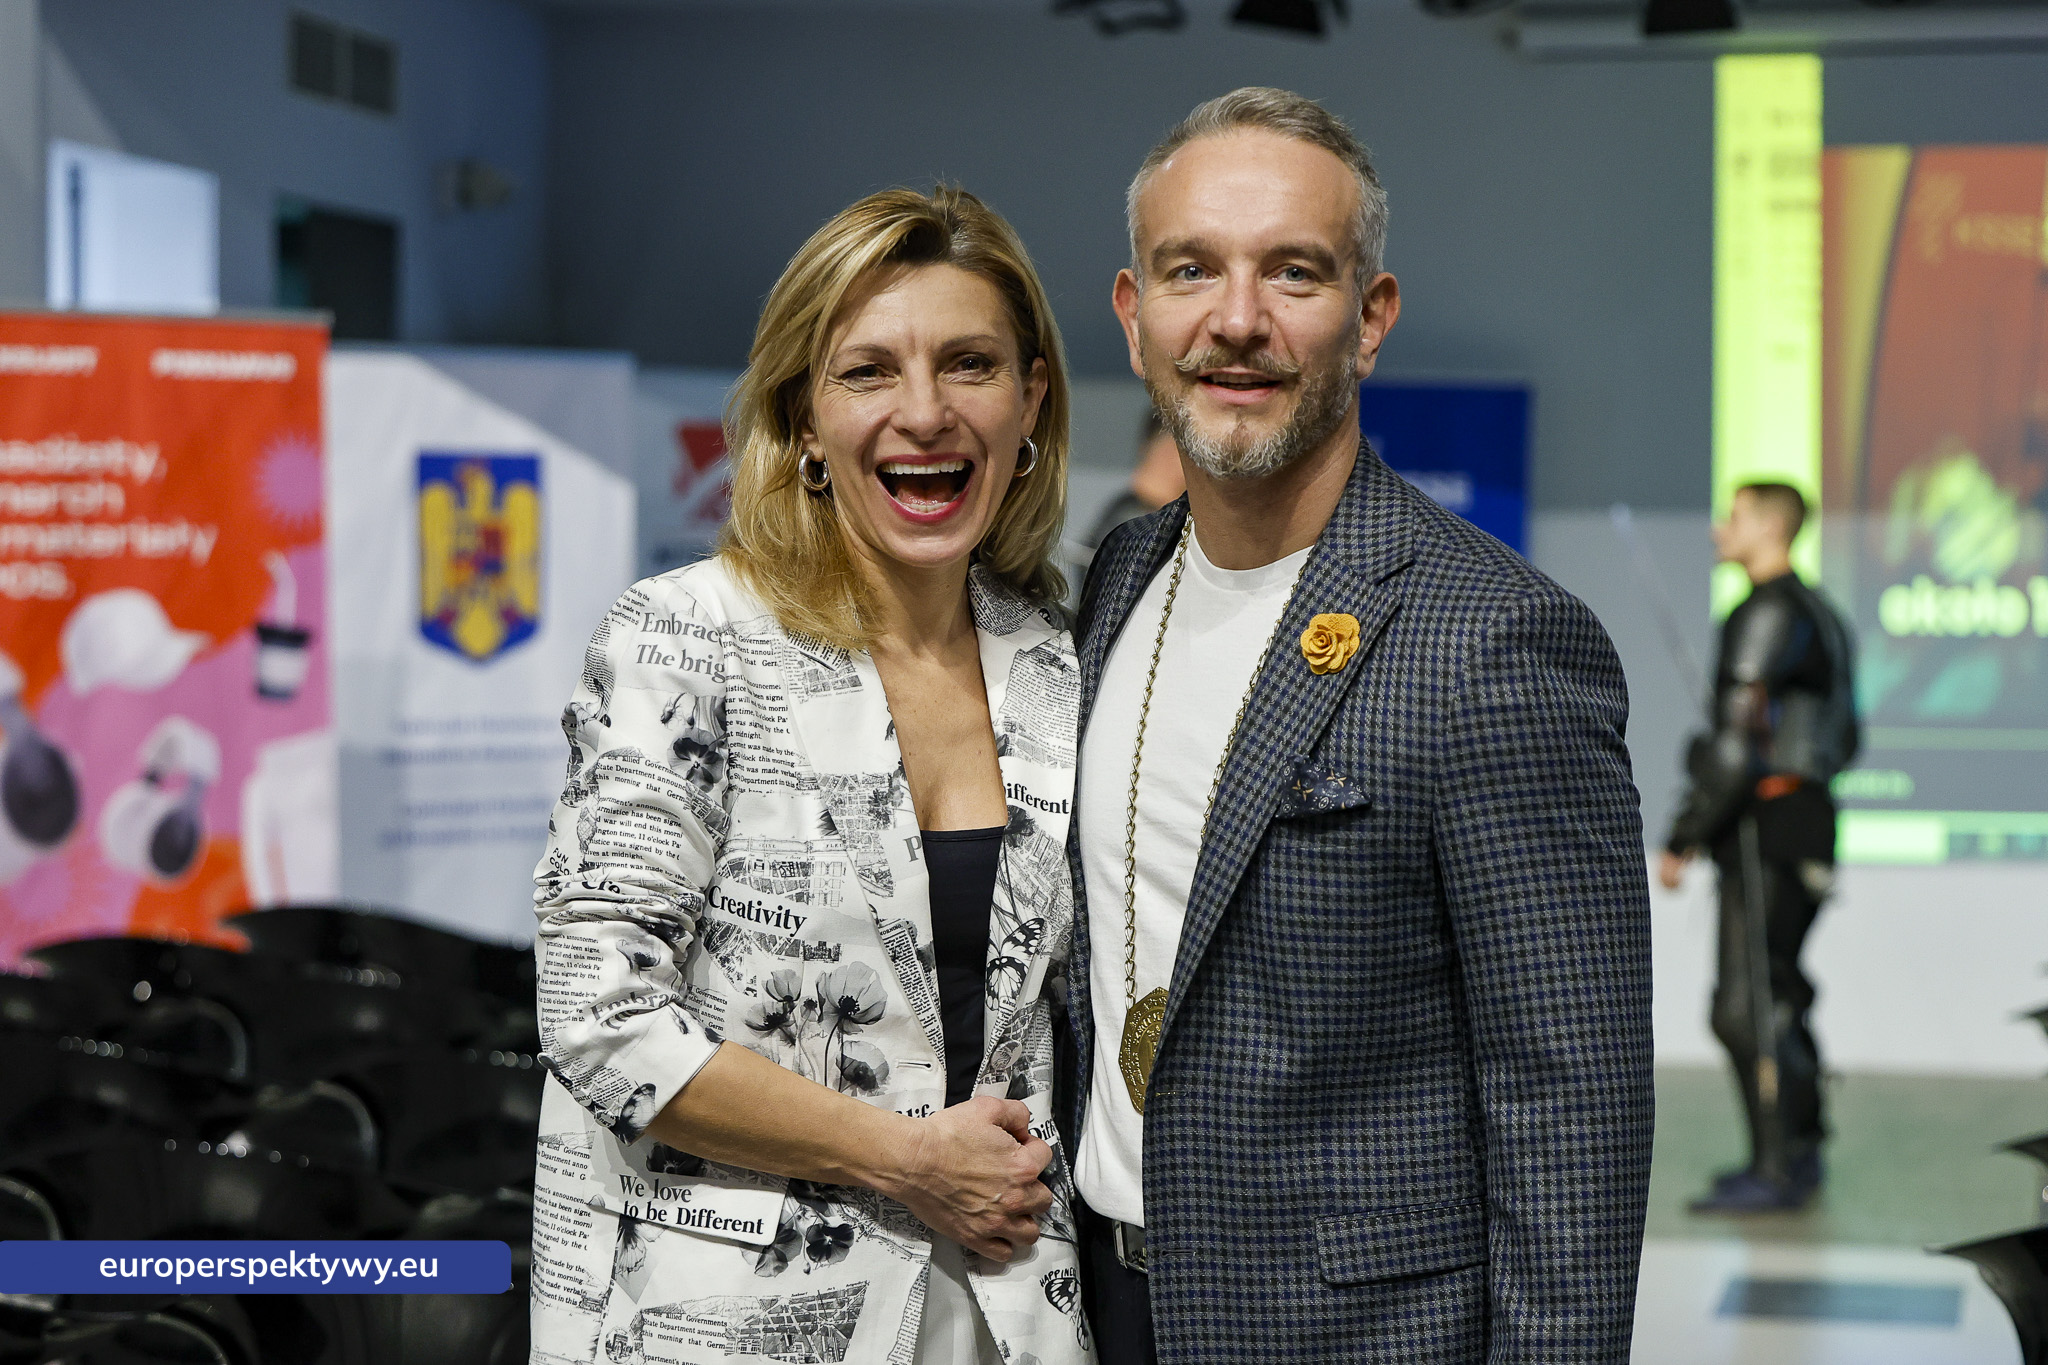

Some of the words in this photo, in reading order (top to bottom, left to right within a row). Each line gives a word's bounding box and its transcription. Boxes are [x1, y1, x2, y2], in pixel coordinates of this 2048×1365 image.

[636, 644, 675, 666] The
[744, 657, 757, 666] that
[773, 726, 784, 734] the
[776, 747, 783, 756] by
[615, 764, 656, 780] Department
[761, 767, 780, 775] made
[614, 776, 641, 788] morning
[646, 783, 661, 794] that
[1004, 782, 1069, 815] ifferent
[631, 809, 644, 819] has
[645, 812, 662, 823] been
[603, 817, 618, 825] war
[619, 819, 632, 828] will
[634, 821, 647, 830] end
[649, 824, 662, 834] this
[619, 831, 637, 840] time,
[638, 832, 646, 841] 11
[647, 835, 670, 846] o'clock
[553, 847, 569, 864] FUN
[613, 840, 627, 848] was
[629, 843, 652, 853] signed
[655, 847, 664, 856] by
[666, 850, 676, 859] the
[645, 865, 664, 874] made
[708, 885, 808, 937] Creativity
[695, 987, 728, 1005] Governments
[541, 1150, 571, 1166] Department
[572, 1161, 589, 1170] anno
[561, 1168, 575, 1178] that
[618, 1173, 645, 1198] We
[653, 1178, 692, 1203] love
[548, 1200, 558, 1209] has
[558, 1202, 572, 1213] been
[549, 1211, 559, 1220] end
[559, 1214, 572, 1224] this
[623, 1200, 639, 1219] to
[645, 1200, 668, 1222] be
[675, 1206, 765, 1235] Different
[556, 1226, 577, 1237] o'clock
[543, 1232, 560, 1243] signed
[561, 1238, 569, 1247] by
[571, 1241, 582, 1250] the
[549, 1258, 565, 1268] made
[566, 1262, 574, 1271] by
[575, 1265, 586, 1274] the
[545, 1268, 556, 1277] this
[557, 1272, 584, 1286] morning
[545, 1280, 561, 1289] made
[558, 1294, 565, 1302] in
[565, 1297, 578, 1307] this
[660, 1321, 696, 1334] Department
[686, 1314, 728, 1328] Governments
[657, 1332, 684, 1344] morning
[688, 1337, 702, 1347] that
